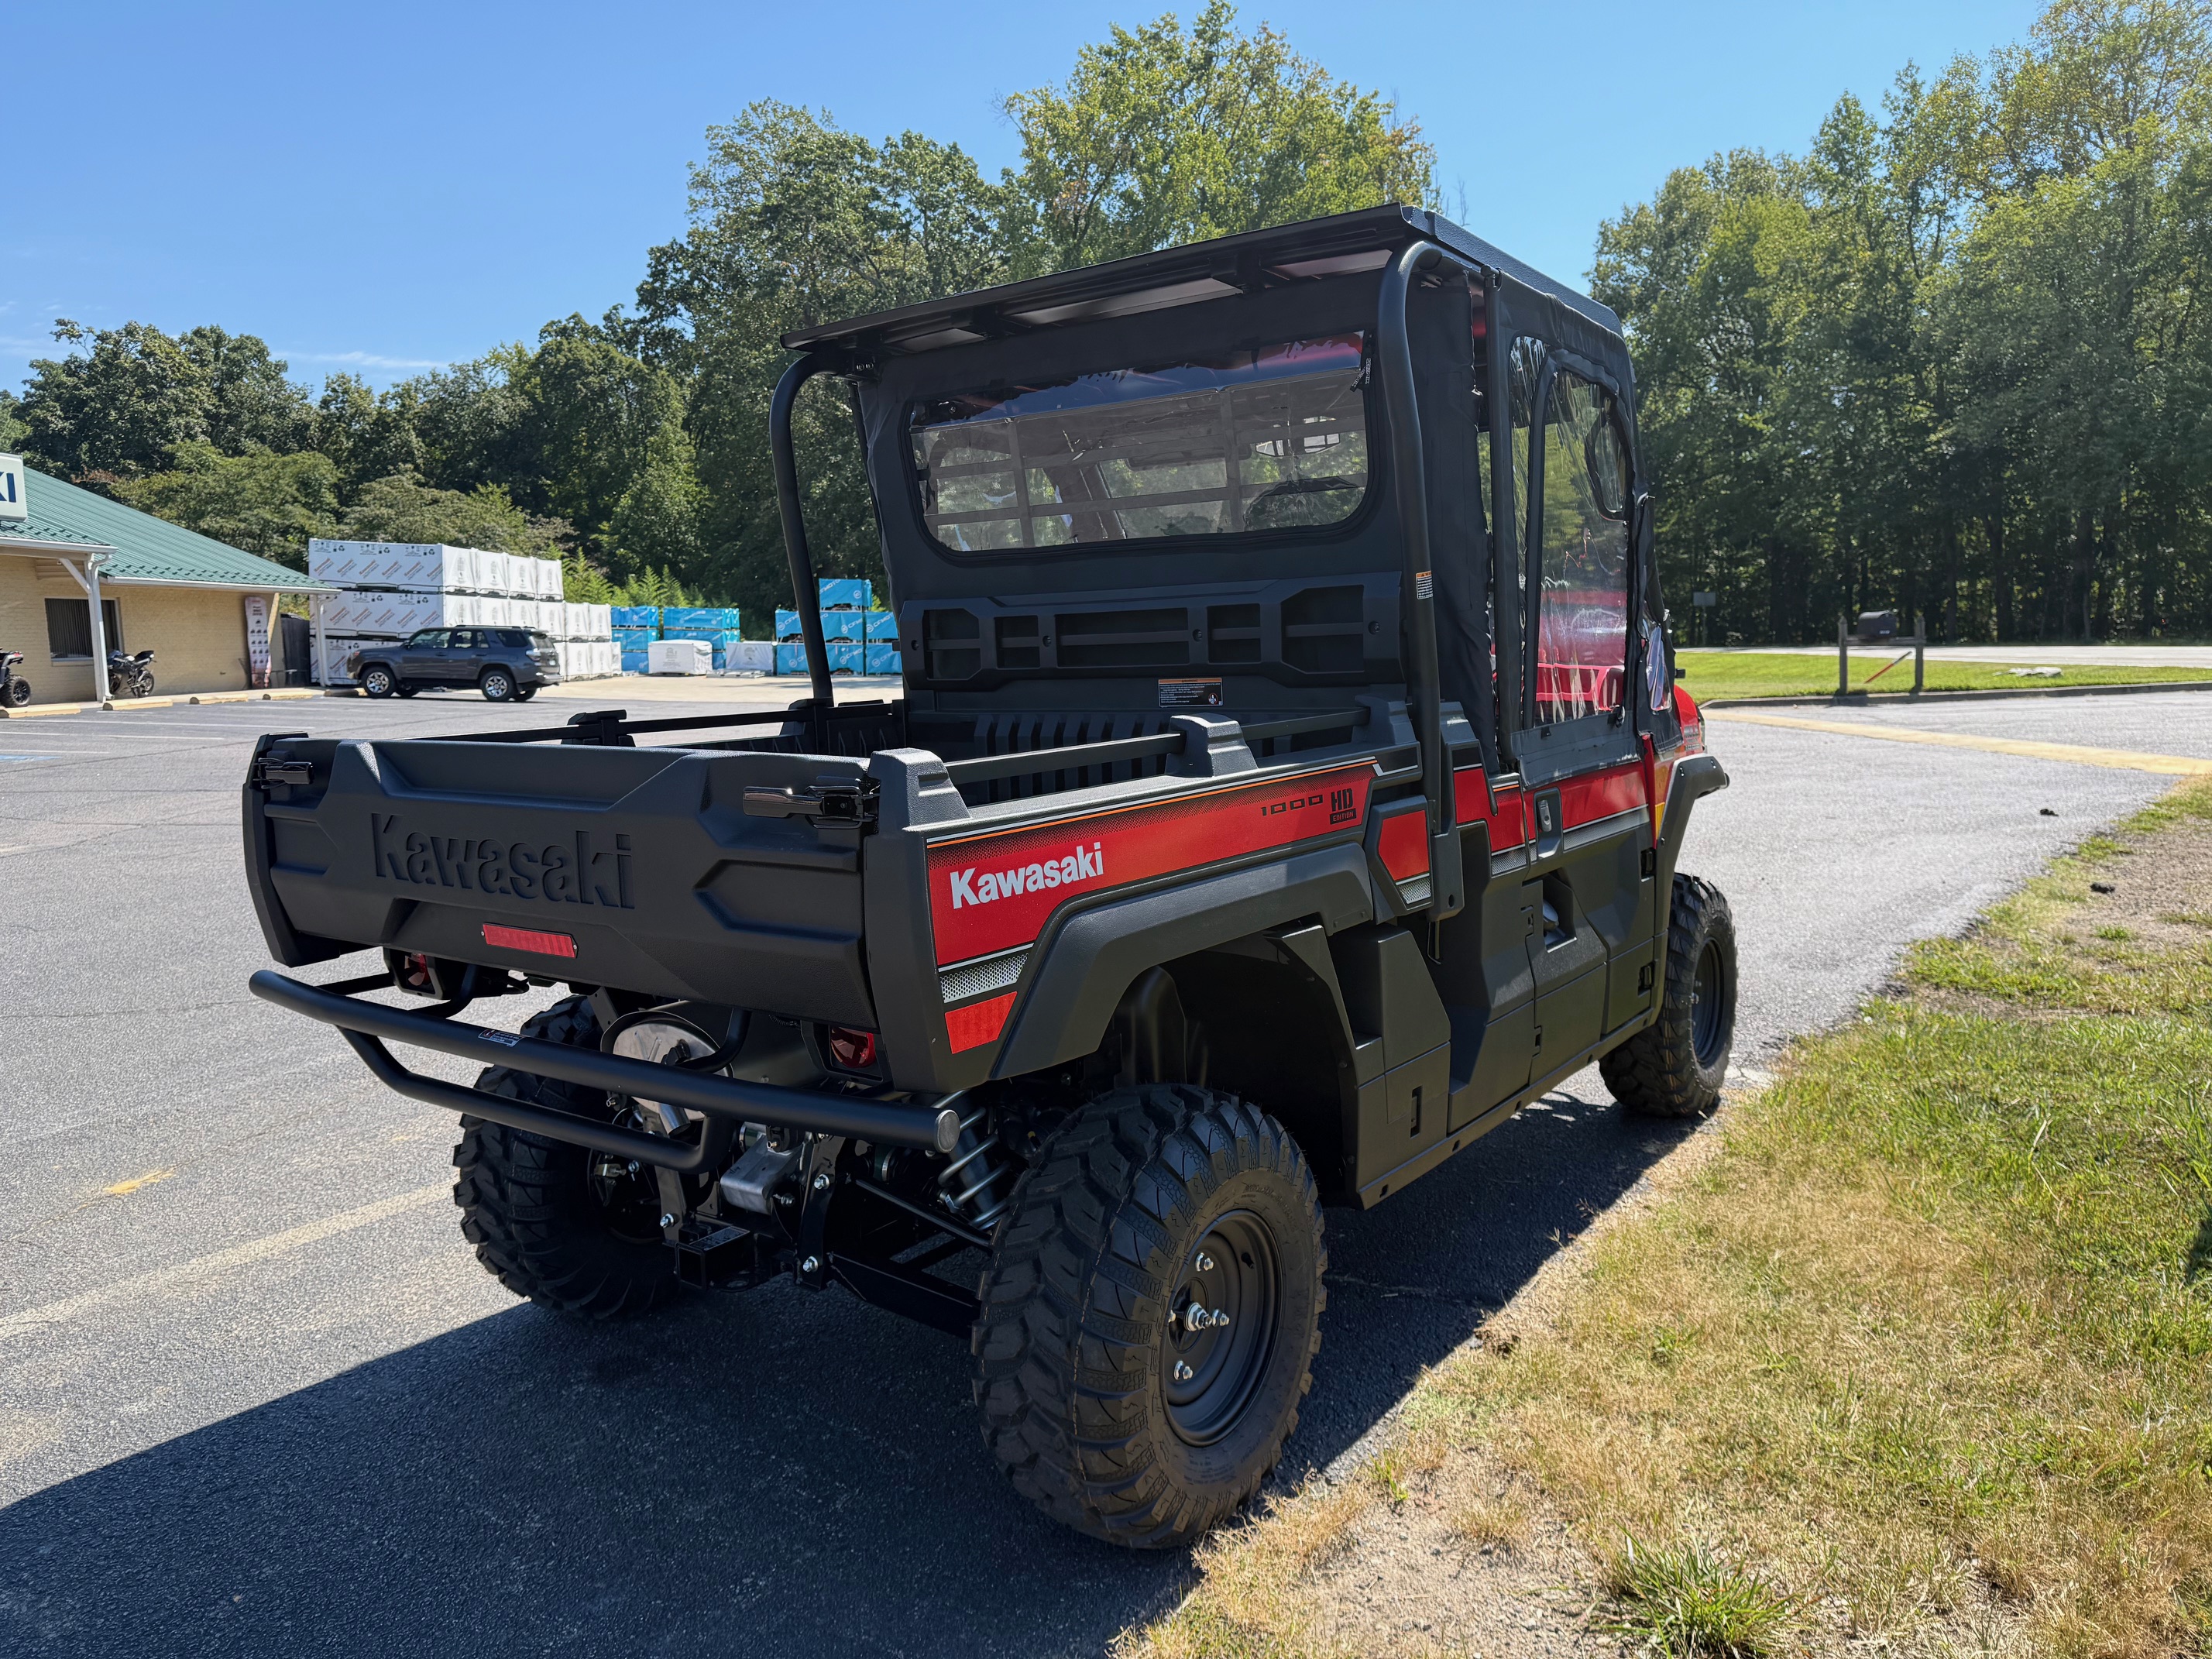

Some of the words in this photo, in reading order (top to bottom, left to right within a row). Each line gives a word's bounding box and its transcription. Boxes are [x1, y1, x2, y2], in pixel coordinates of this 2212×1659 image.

[0, 472, 16, 503] I
[1261, 794, 1323, 816] 1000
[1331, 788, 1353, 811] HD
[1333, 812, 1354, 822] EDITION
[372, 812, 636, 910] Kawasaki
[950, 842, 1104, 910] Kawasaki
